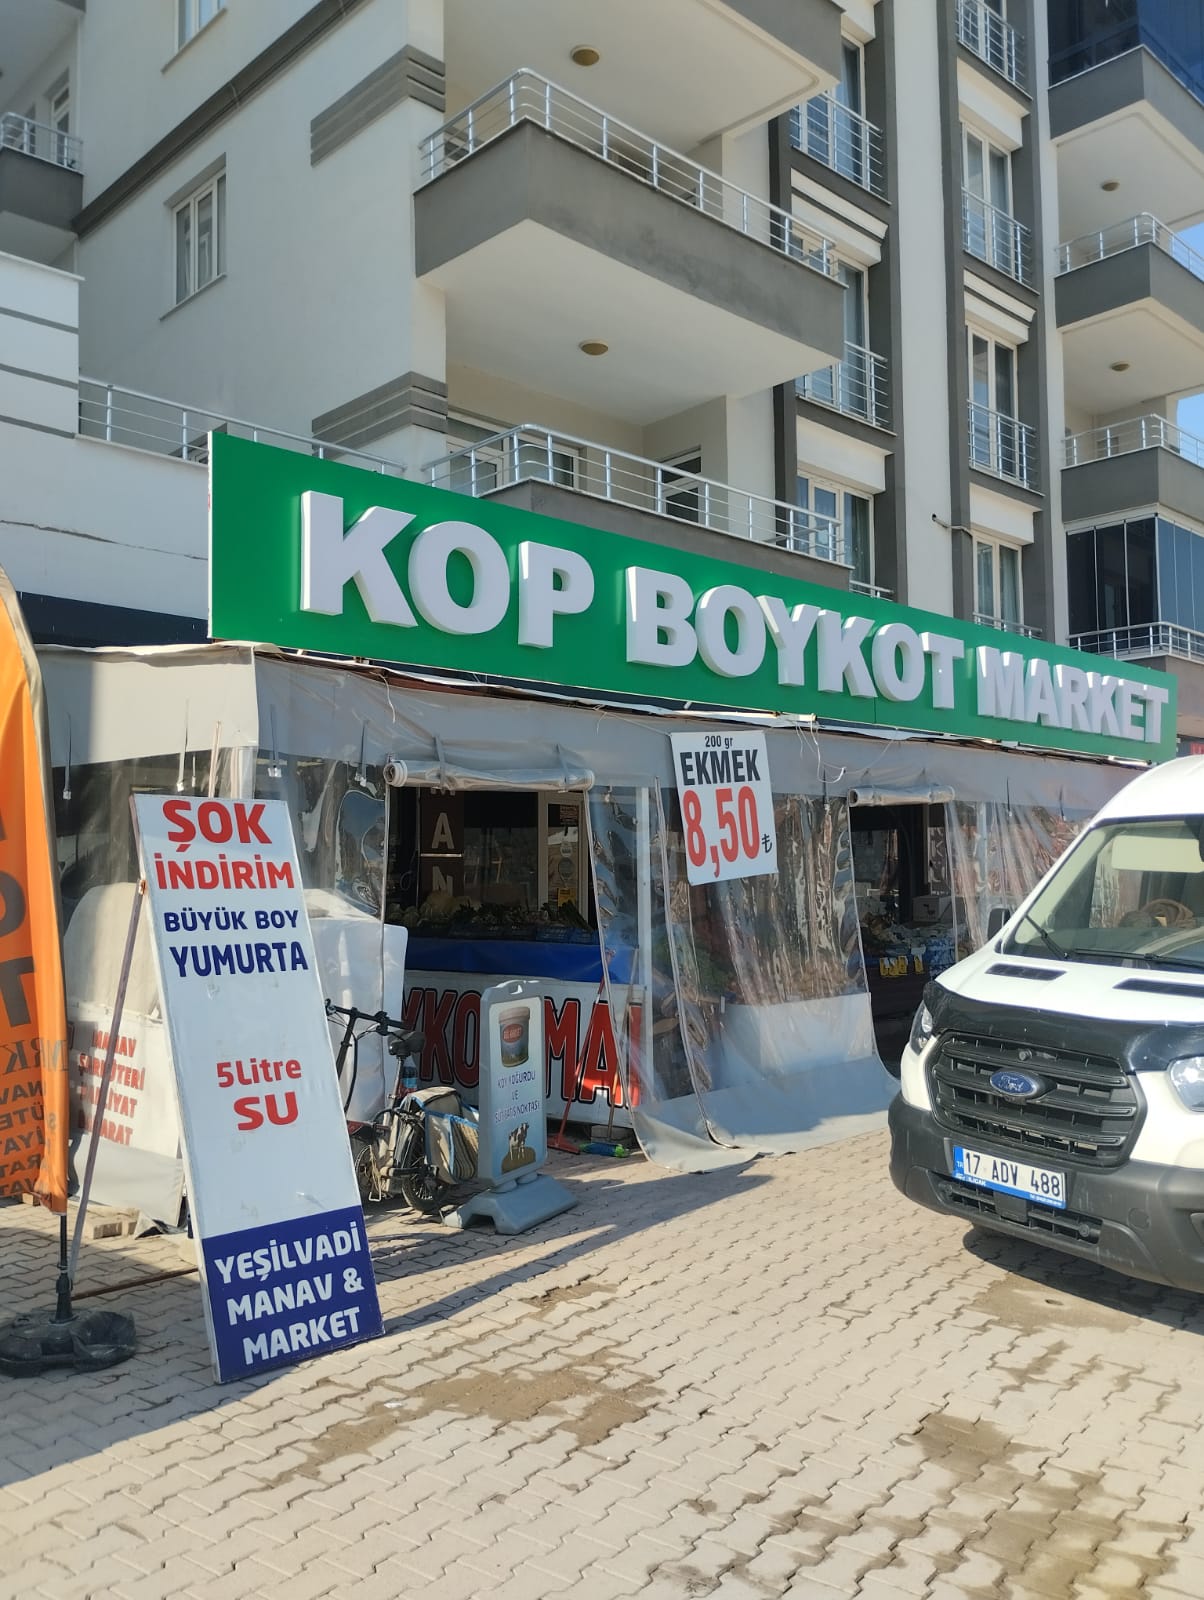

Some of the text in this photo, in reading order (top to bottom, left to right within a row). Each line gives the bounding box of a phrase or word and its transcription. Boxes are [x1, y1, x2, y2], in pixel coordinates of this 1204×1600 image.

[300, 490, 1168, 743] KOP BOYKOT MARKET
[704, 735, 734, 749] 200 gr
[680, 749, 760, 786] EKMEK
[162, 800, 272, 852] ŞOK
[154, 853, 295, 889] İNDİRİM
[164, 907, 298, 932] BÜYÜK BOY
[169, 941, 309, 977] YUMURTA
[92, 1030, 137, 1058] MAAV
[233, 1091, 299, 1131] SU
[965, 1152, 1060, 1197] 17 ADV 488
[214, 1221, 361, 1284] YEŞİLVADİ
[226, 1267, 365, 1326] MANAV &
[242, 1306, 360, 1365] MARKET
